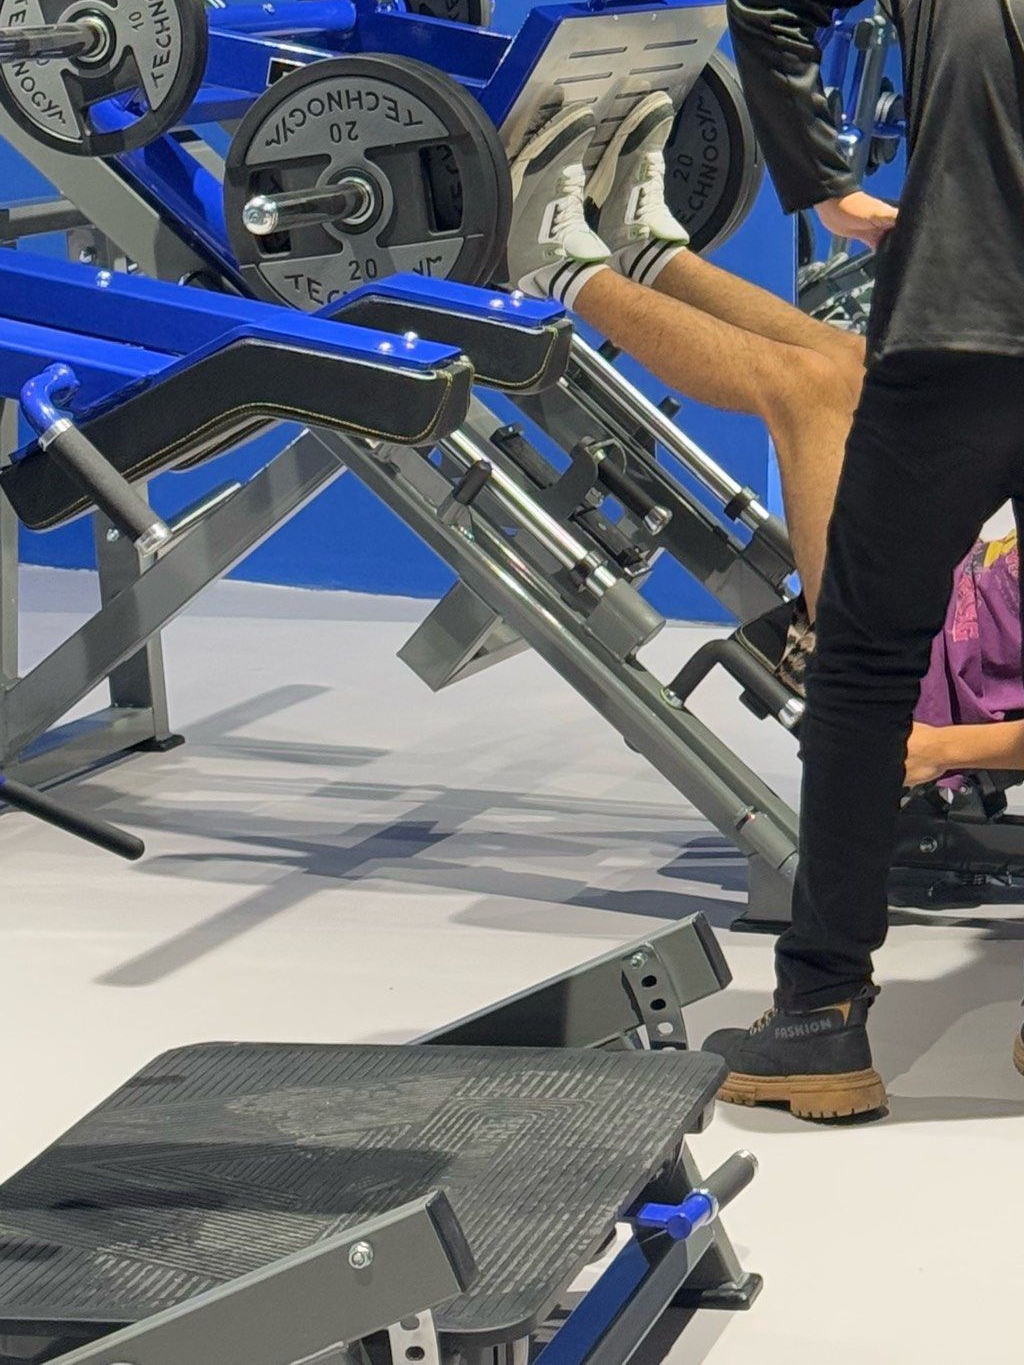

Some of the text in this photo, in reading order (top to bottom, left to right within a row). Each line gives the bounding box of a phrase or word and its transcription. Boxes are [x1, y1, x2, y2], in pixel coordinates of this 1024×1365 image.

[128, 11, 145, 31] 10
[265, 90, 423, 148] TECHNOGYM
[330, 121, 360, 143] 20
[673, 154, 694, 183] 20
[676, 94, 719, 225] ECHNOGYM
[349, 258, 378, 281] 20
